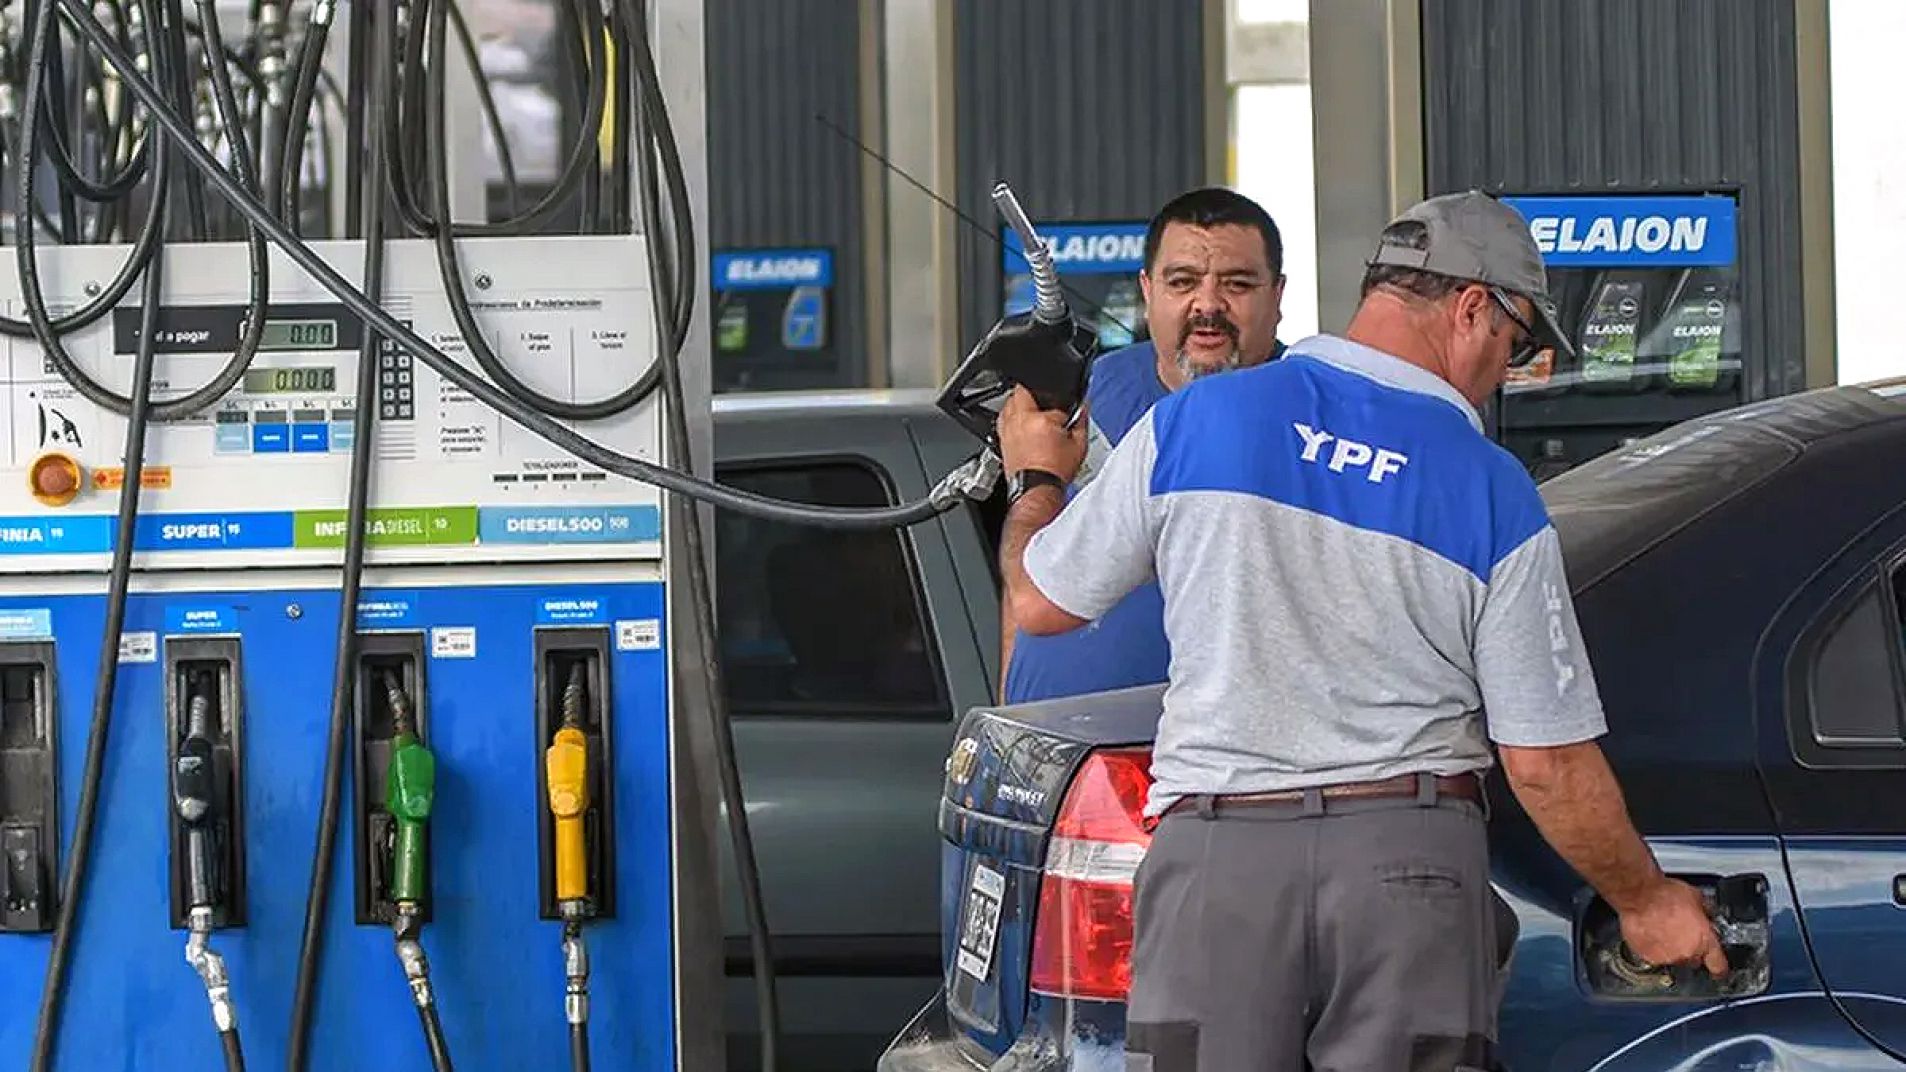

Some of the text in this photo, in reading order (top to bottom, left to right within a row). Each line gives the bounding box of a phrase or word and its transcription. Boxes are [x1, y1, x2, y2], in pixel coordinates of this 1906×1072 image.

[1530, 217, 1708, 253] ELAION
[1036, 234, 1147, 262] LAION
[727, 258, 820, 281] ELAION
[175, 330, 210, 345] pagar
[1585, 323, 1636, 336] ELAION
[1673, 325, 1723, 338] ELAION
[1293, 422, 1409, 484] YPF
[162, 523, 222, 540] SUPER
[506, 516, 603, 533] DIESEL500
[0, 527, 44, 542] INIA
